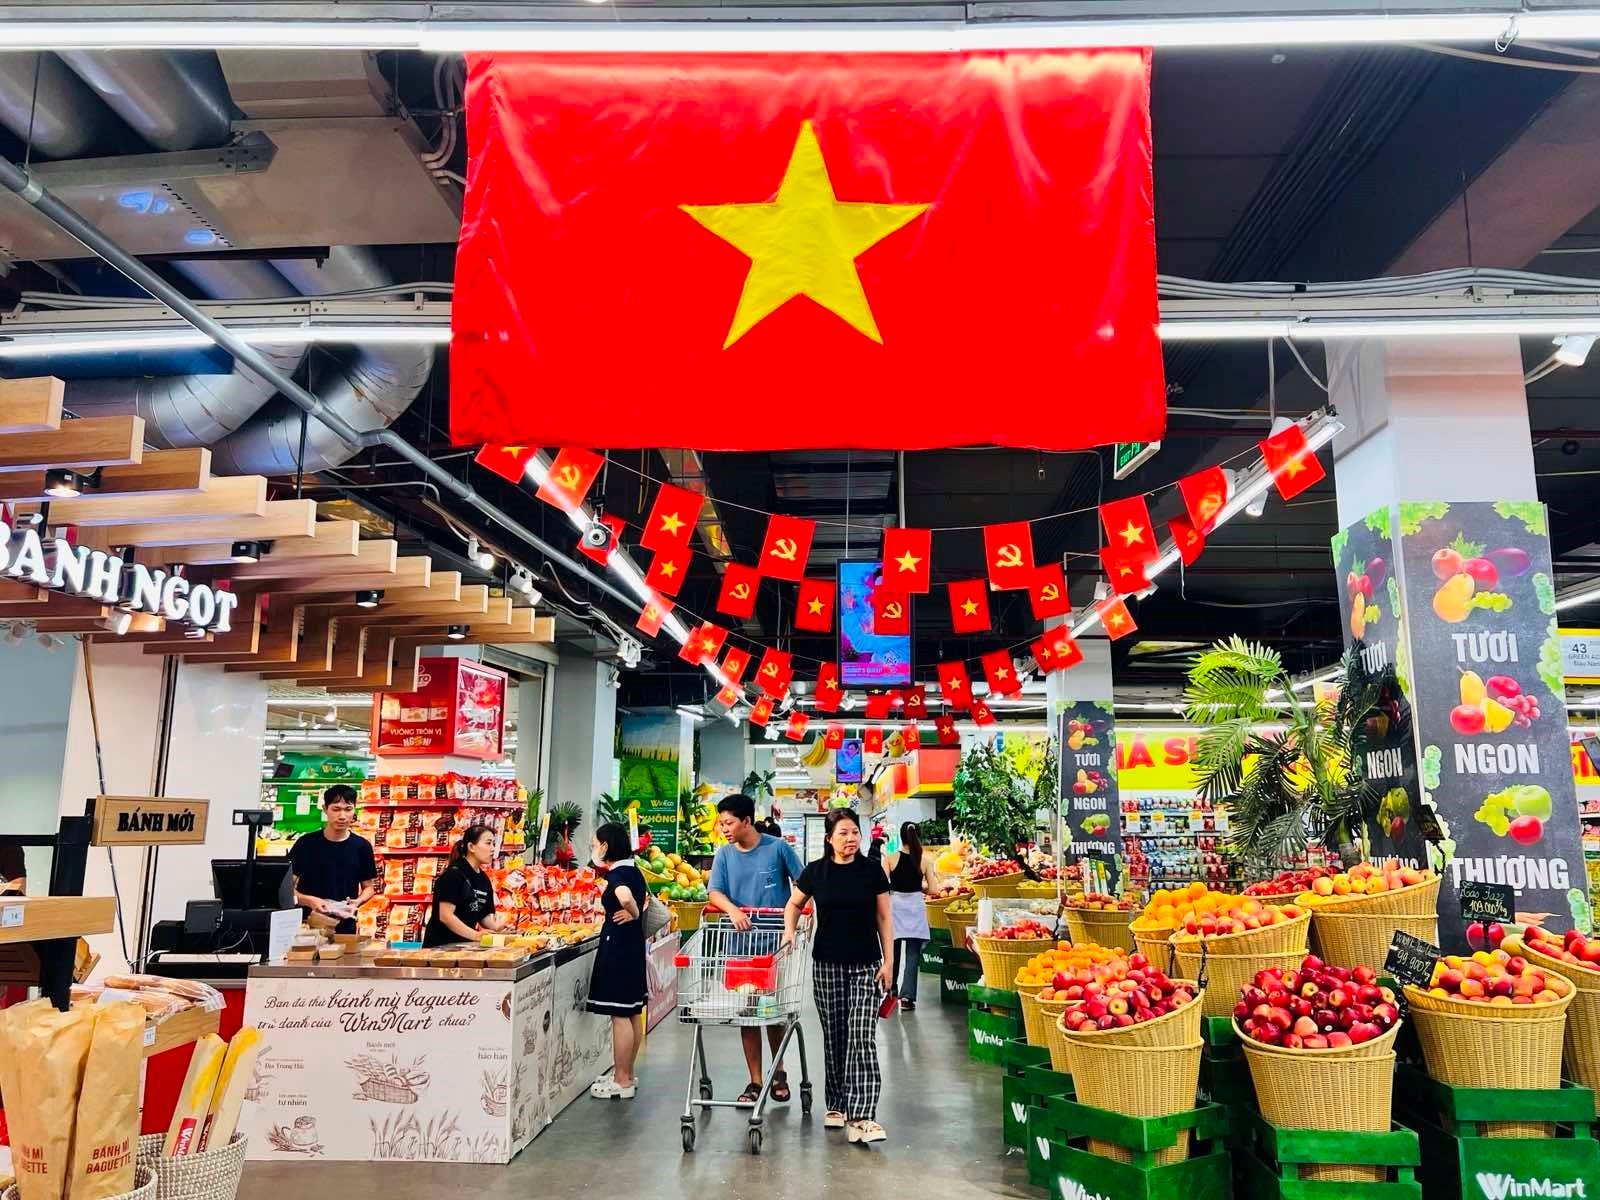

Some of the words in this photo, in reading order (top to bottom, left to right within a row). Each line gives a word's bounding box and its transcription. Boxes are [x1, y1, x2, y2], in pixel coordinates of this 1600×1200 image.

[132, 564, 238, 638] NGỌT
[1360, 640, 1388, 675] TƯƠI
[1452, 630, 1519, 663] TƯƠI
[1572, 643, 1588, 654] 43
[1074, 752, 1101, 767] TƯƠI
[1366, 747, 1403, 779] NGON
[1454, 743, 1540, 774] NGON
[1073, 797, 1107, 810] NGON
[117, 806, 164, 832] BÁNH
[166, 808, 196, 832] MỚI
[1452, 853, 1570, 897] THƯỢNG
[923, 953, 944, 964] WinMa
[327, 988, 374, 1009] bánh
[404, 988, 479, 1013] baguette
[339, 1010, 433, 1033] WinMart
[974, 1028, 1005, 1047] WinMa
[92, 1143, 121, 1161] BÁNH
[1476, 1171, 1587, 1200] WinMart
